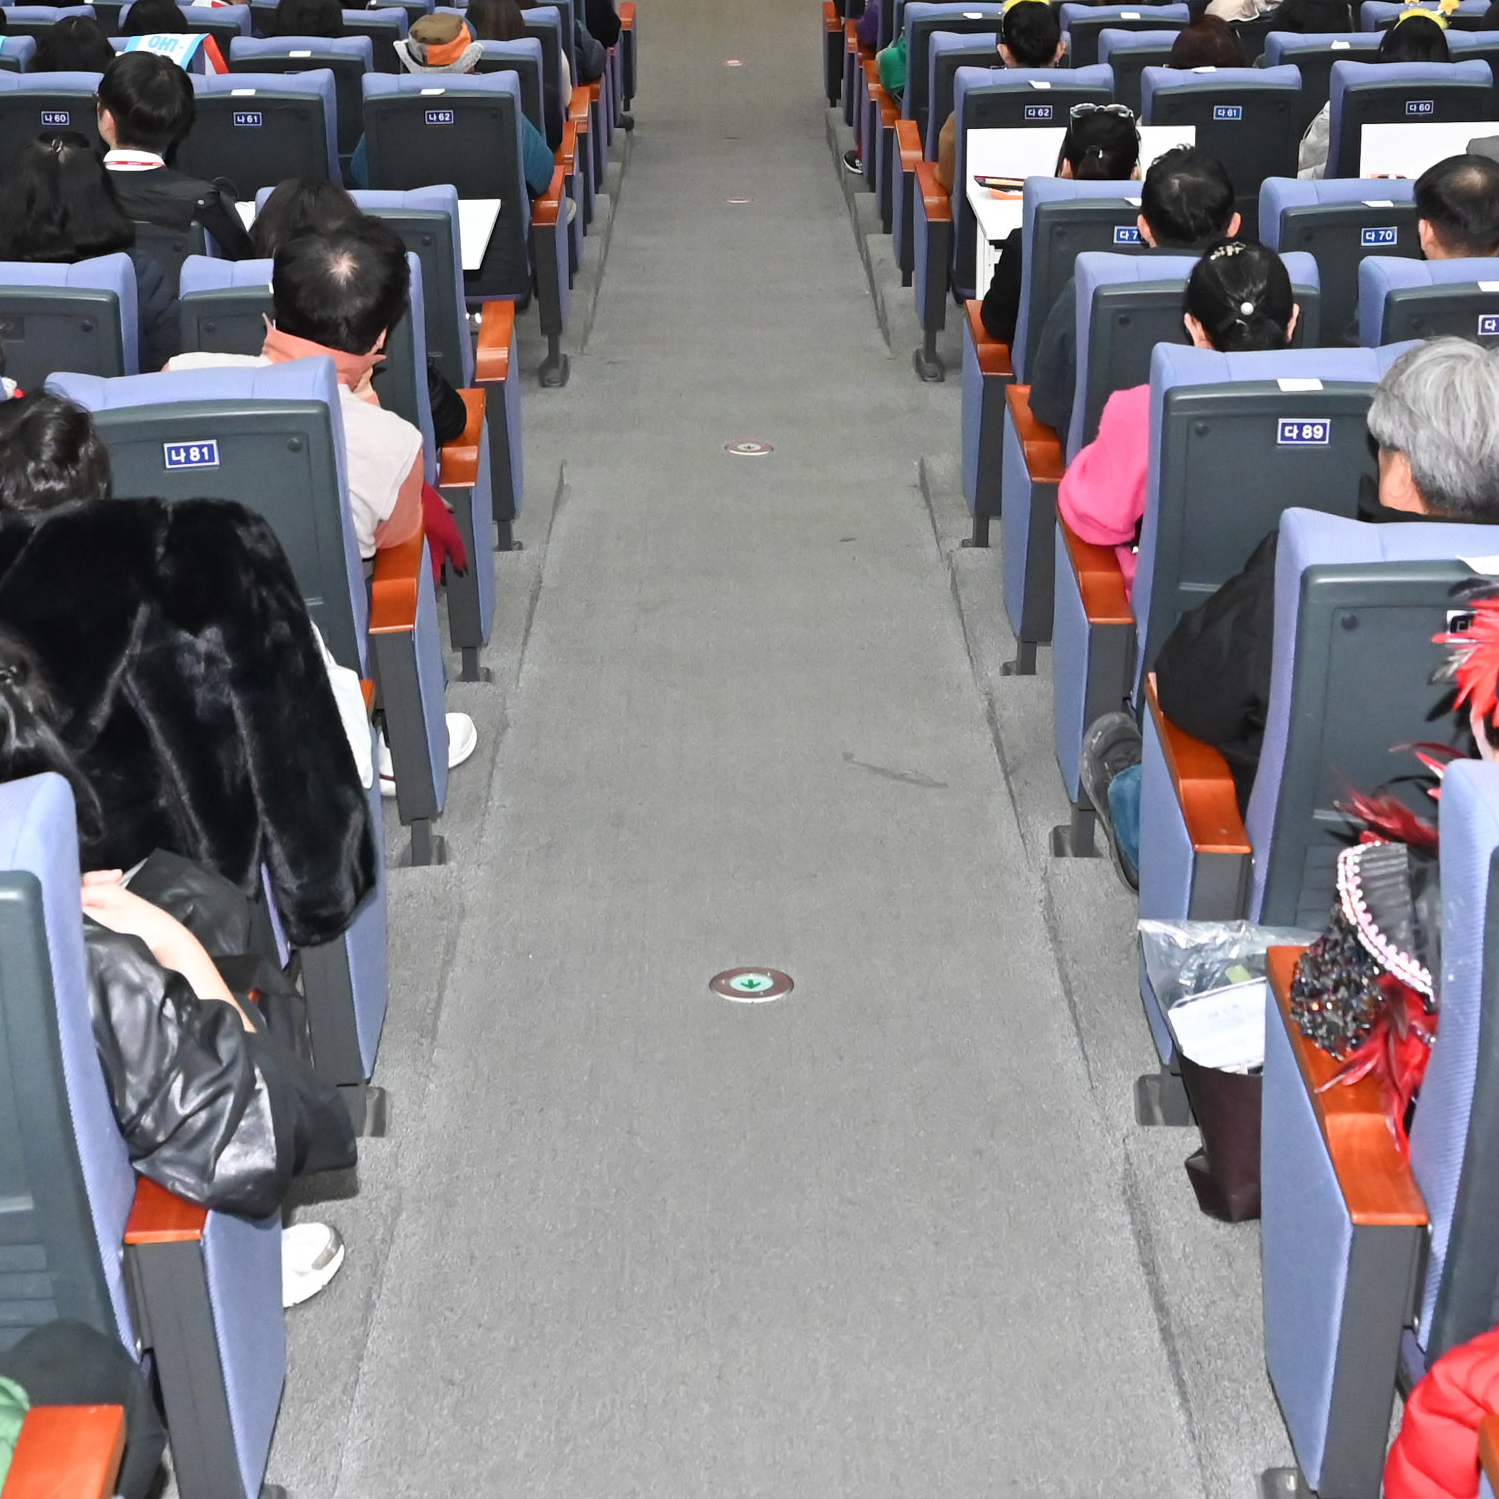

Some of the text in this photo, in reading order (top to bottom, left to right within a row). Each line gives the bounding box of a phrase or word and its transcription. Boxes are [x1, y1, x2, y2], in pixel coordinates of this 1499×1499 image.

[1418, 102, 1431, 111] 60
[438, 112, 451, 121] 62
[1037, 108, 1050, 117] 62
[1227, 108, 1238, 117] 61
[54, 113, 67, 122] 60
[246, 114, 258, 123] 61
[1378, 230, 1394, 241] 70
[1284, 424, 1324, 440] 다 89
[170, 446, 209, 462] 나 81
